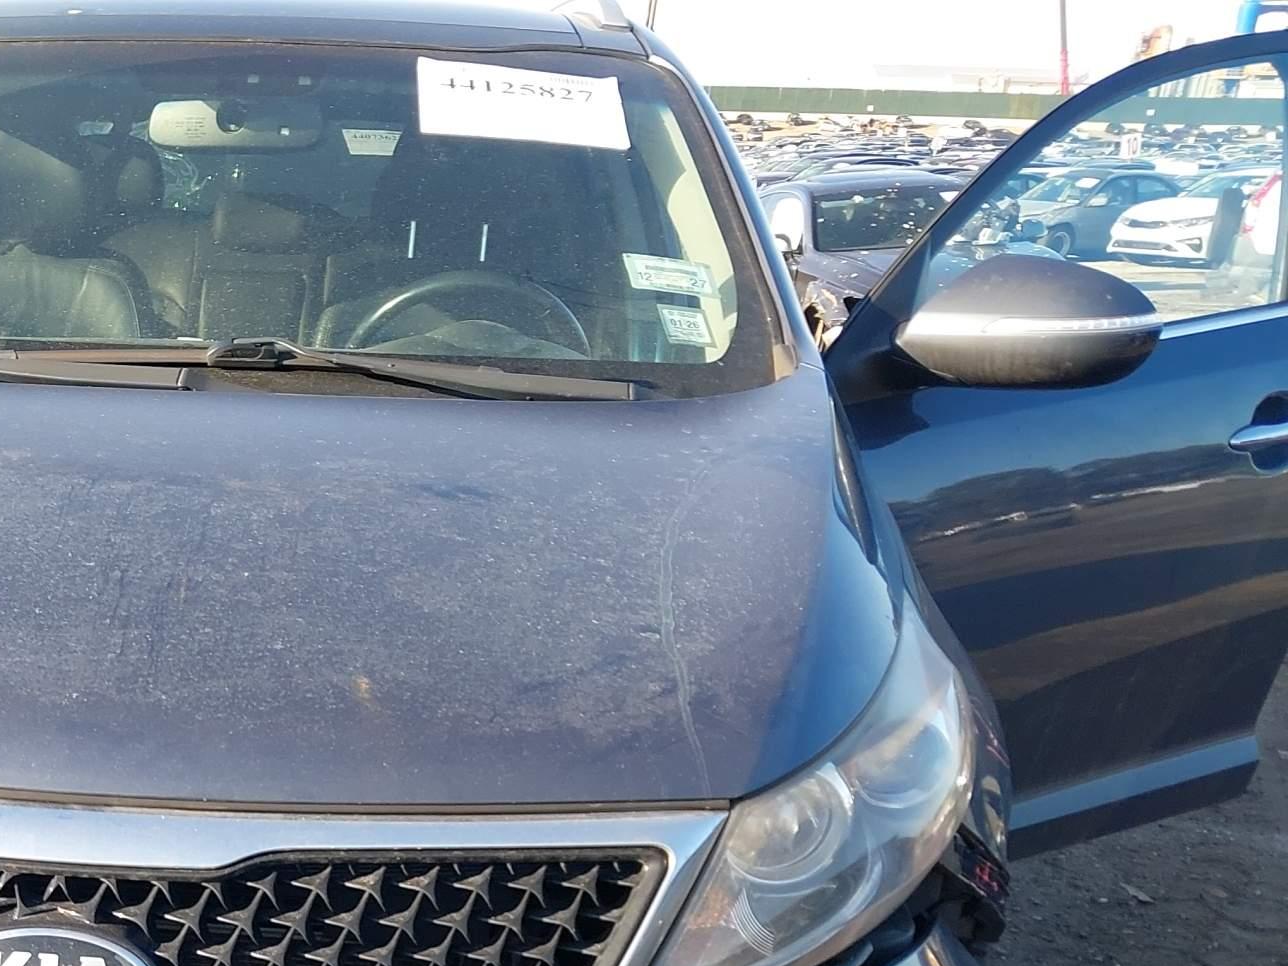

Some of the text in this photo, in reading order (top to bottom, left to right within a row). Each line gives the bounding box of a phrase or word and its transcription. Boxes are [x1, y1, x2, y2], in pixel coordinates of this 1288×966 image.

[440, 76, 594, 103] 44125827
[637, 271, 654, 283] 12
[688, 277, 707, 289] 27
